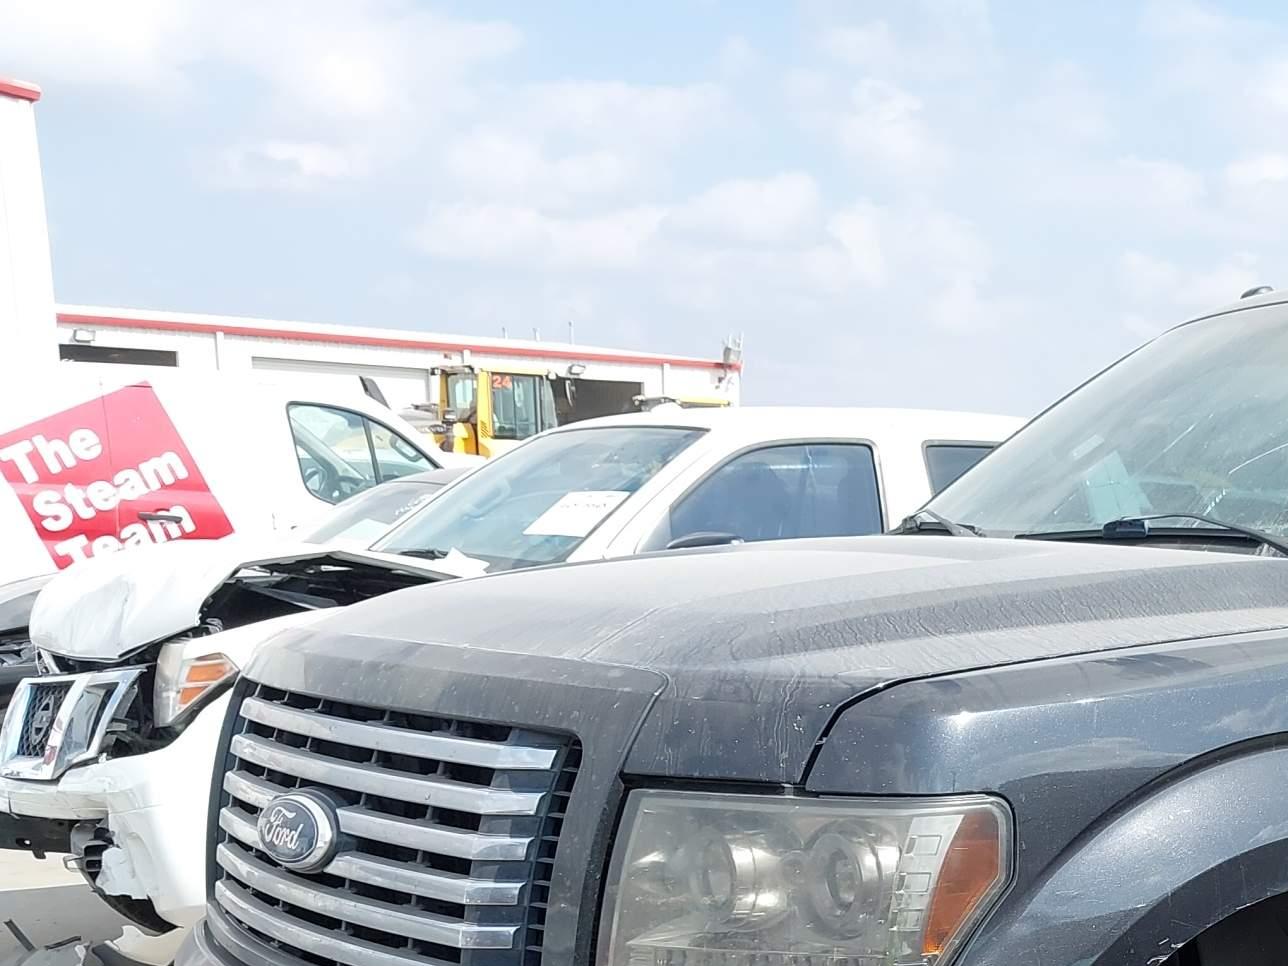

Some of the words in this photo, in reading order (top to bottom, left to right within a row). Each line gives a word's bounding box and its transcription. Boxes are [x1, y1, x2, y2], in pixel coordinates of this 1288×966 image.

[0, 427, 102, 484] The
[32, 450, 190, 532] Steam
[54, 504, 197, 560] Team
[264, 806, 304, 850] Ford
